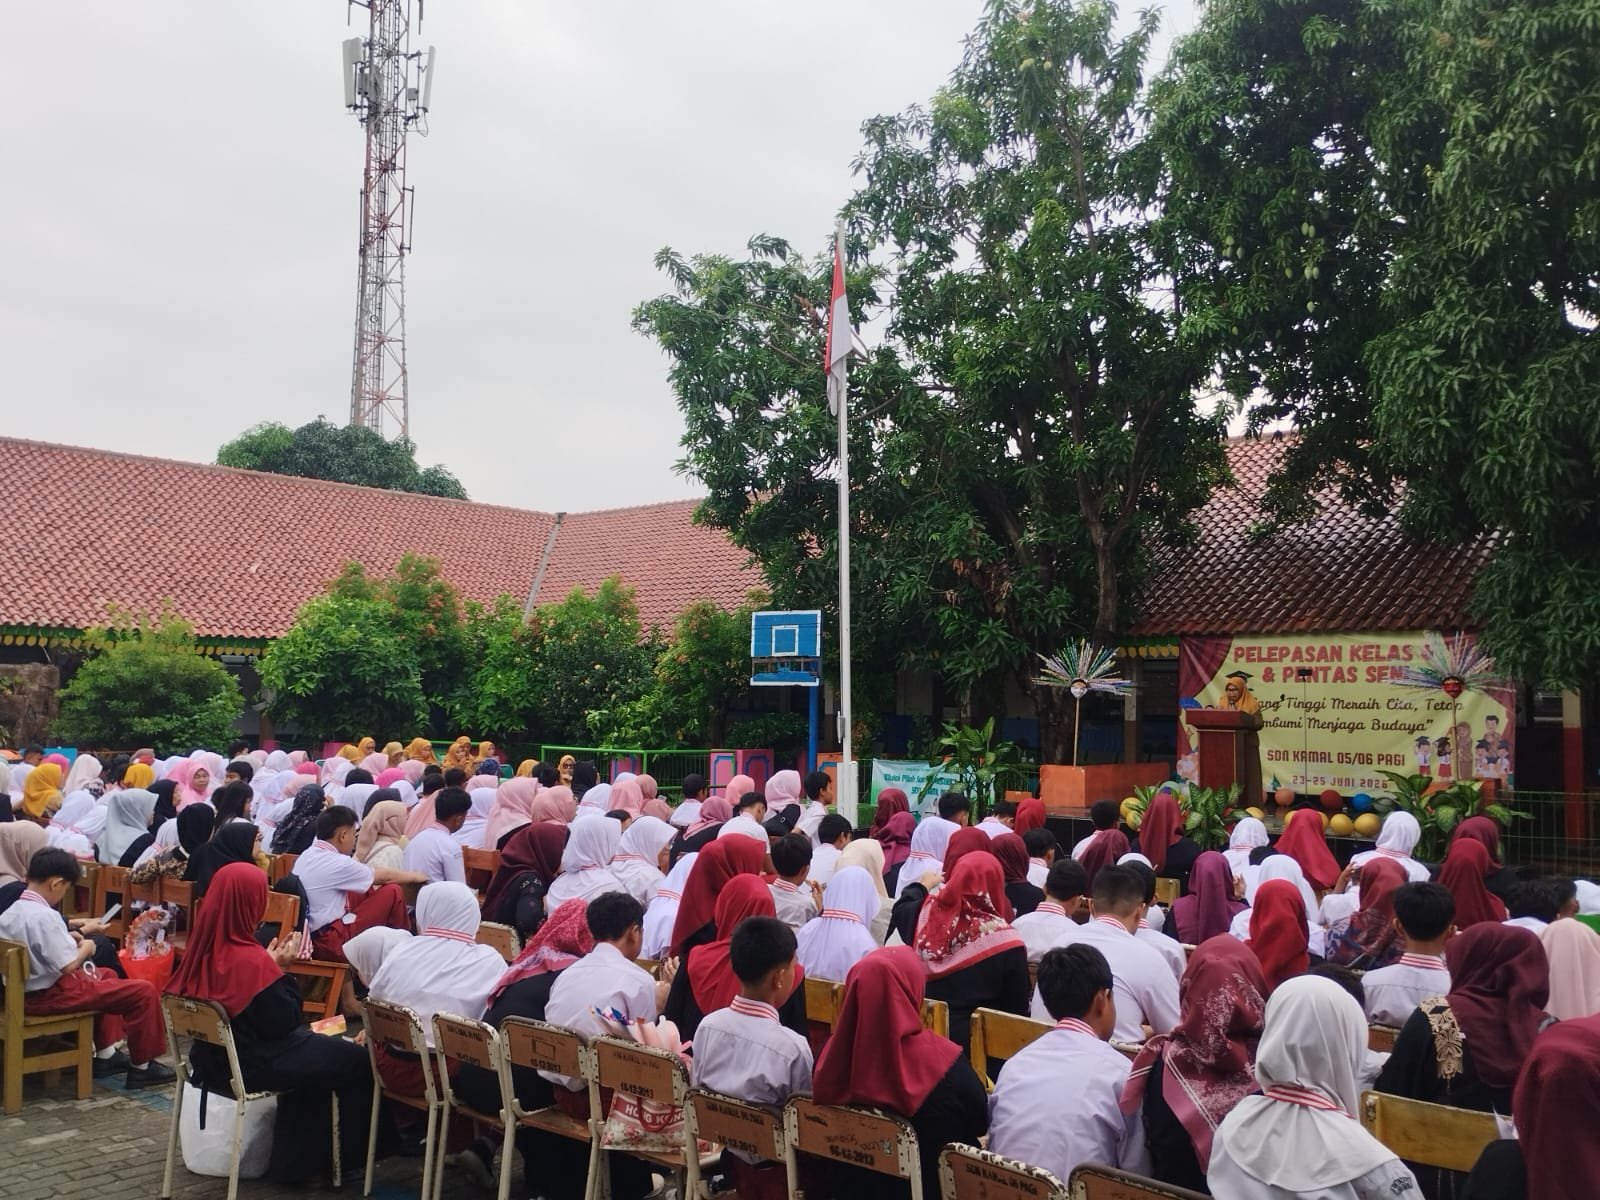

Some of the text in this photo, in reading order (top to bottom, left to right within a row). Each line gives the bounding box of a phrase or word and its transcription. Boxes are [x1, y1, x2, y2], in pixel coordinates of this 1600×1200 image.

[1233, 645, 1343, 664] PELEPASAN
[1349, 644, 1414, 662] KELAS
[1262, 666, 1276, 684] &
[1282, 665, 1358, 684] PENTAS
[1285, 697, 1328, 713] Tinggi
[1330, 697, 1381, 711] Meraih
[1262, 716, 1304, 729] mbumi
[1306, 717, 1366, 734] Menjaga
[1267, 749, 1406, 767] SDN KAMAL 05/06 PAGI
[1331, 776, 1355, 788] JUNI
